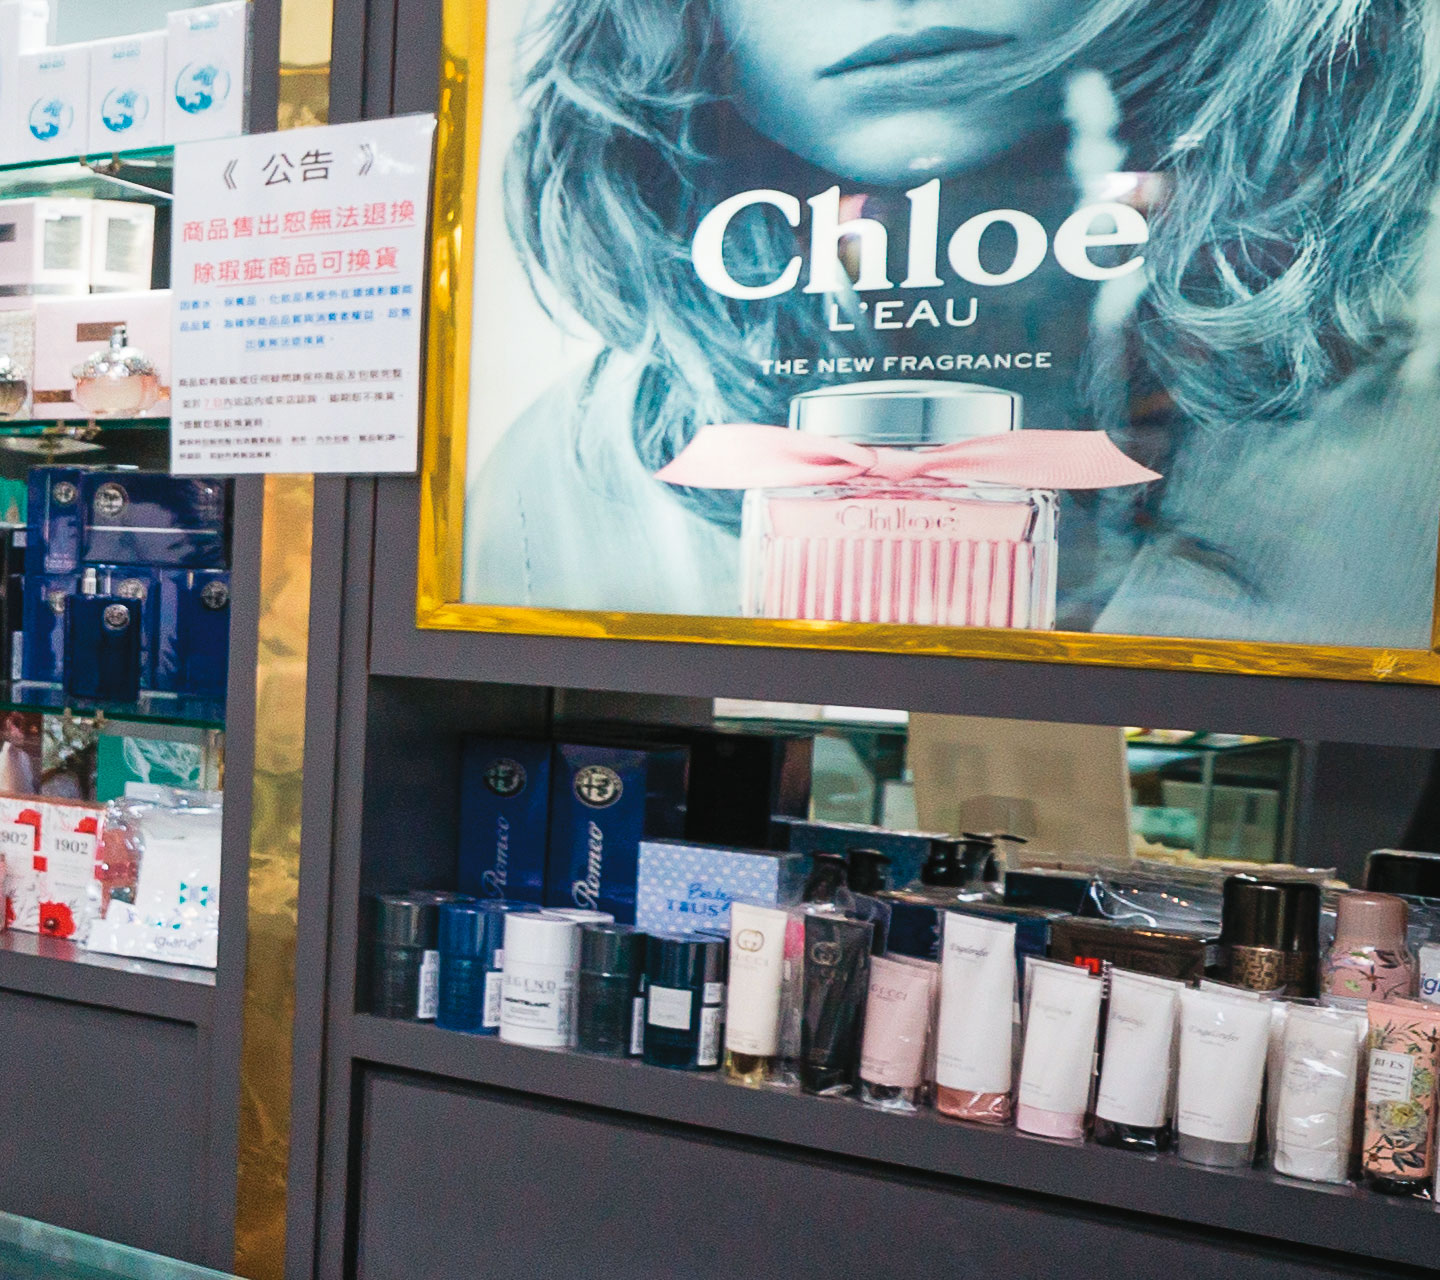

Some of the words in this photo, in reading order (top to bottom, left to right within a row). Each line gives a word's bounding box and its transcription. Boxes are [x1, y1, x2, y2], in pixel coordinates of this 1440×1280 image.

[262, 149, 334, 188] 公告
[828, 297, 979, 332] L'EAU
[760, 359, 810, 376] THE
[818, 356, 876, 375] NEW
[882, 351, 1053, 373] FRAGRANCE
[55, 837, 89, 855] 1902
[573, 820, 604, 911] Romeo
